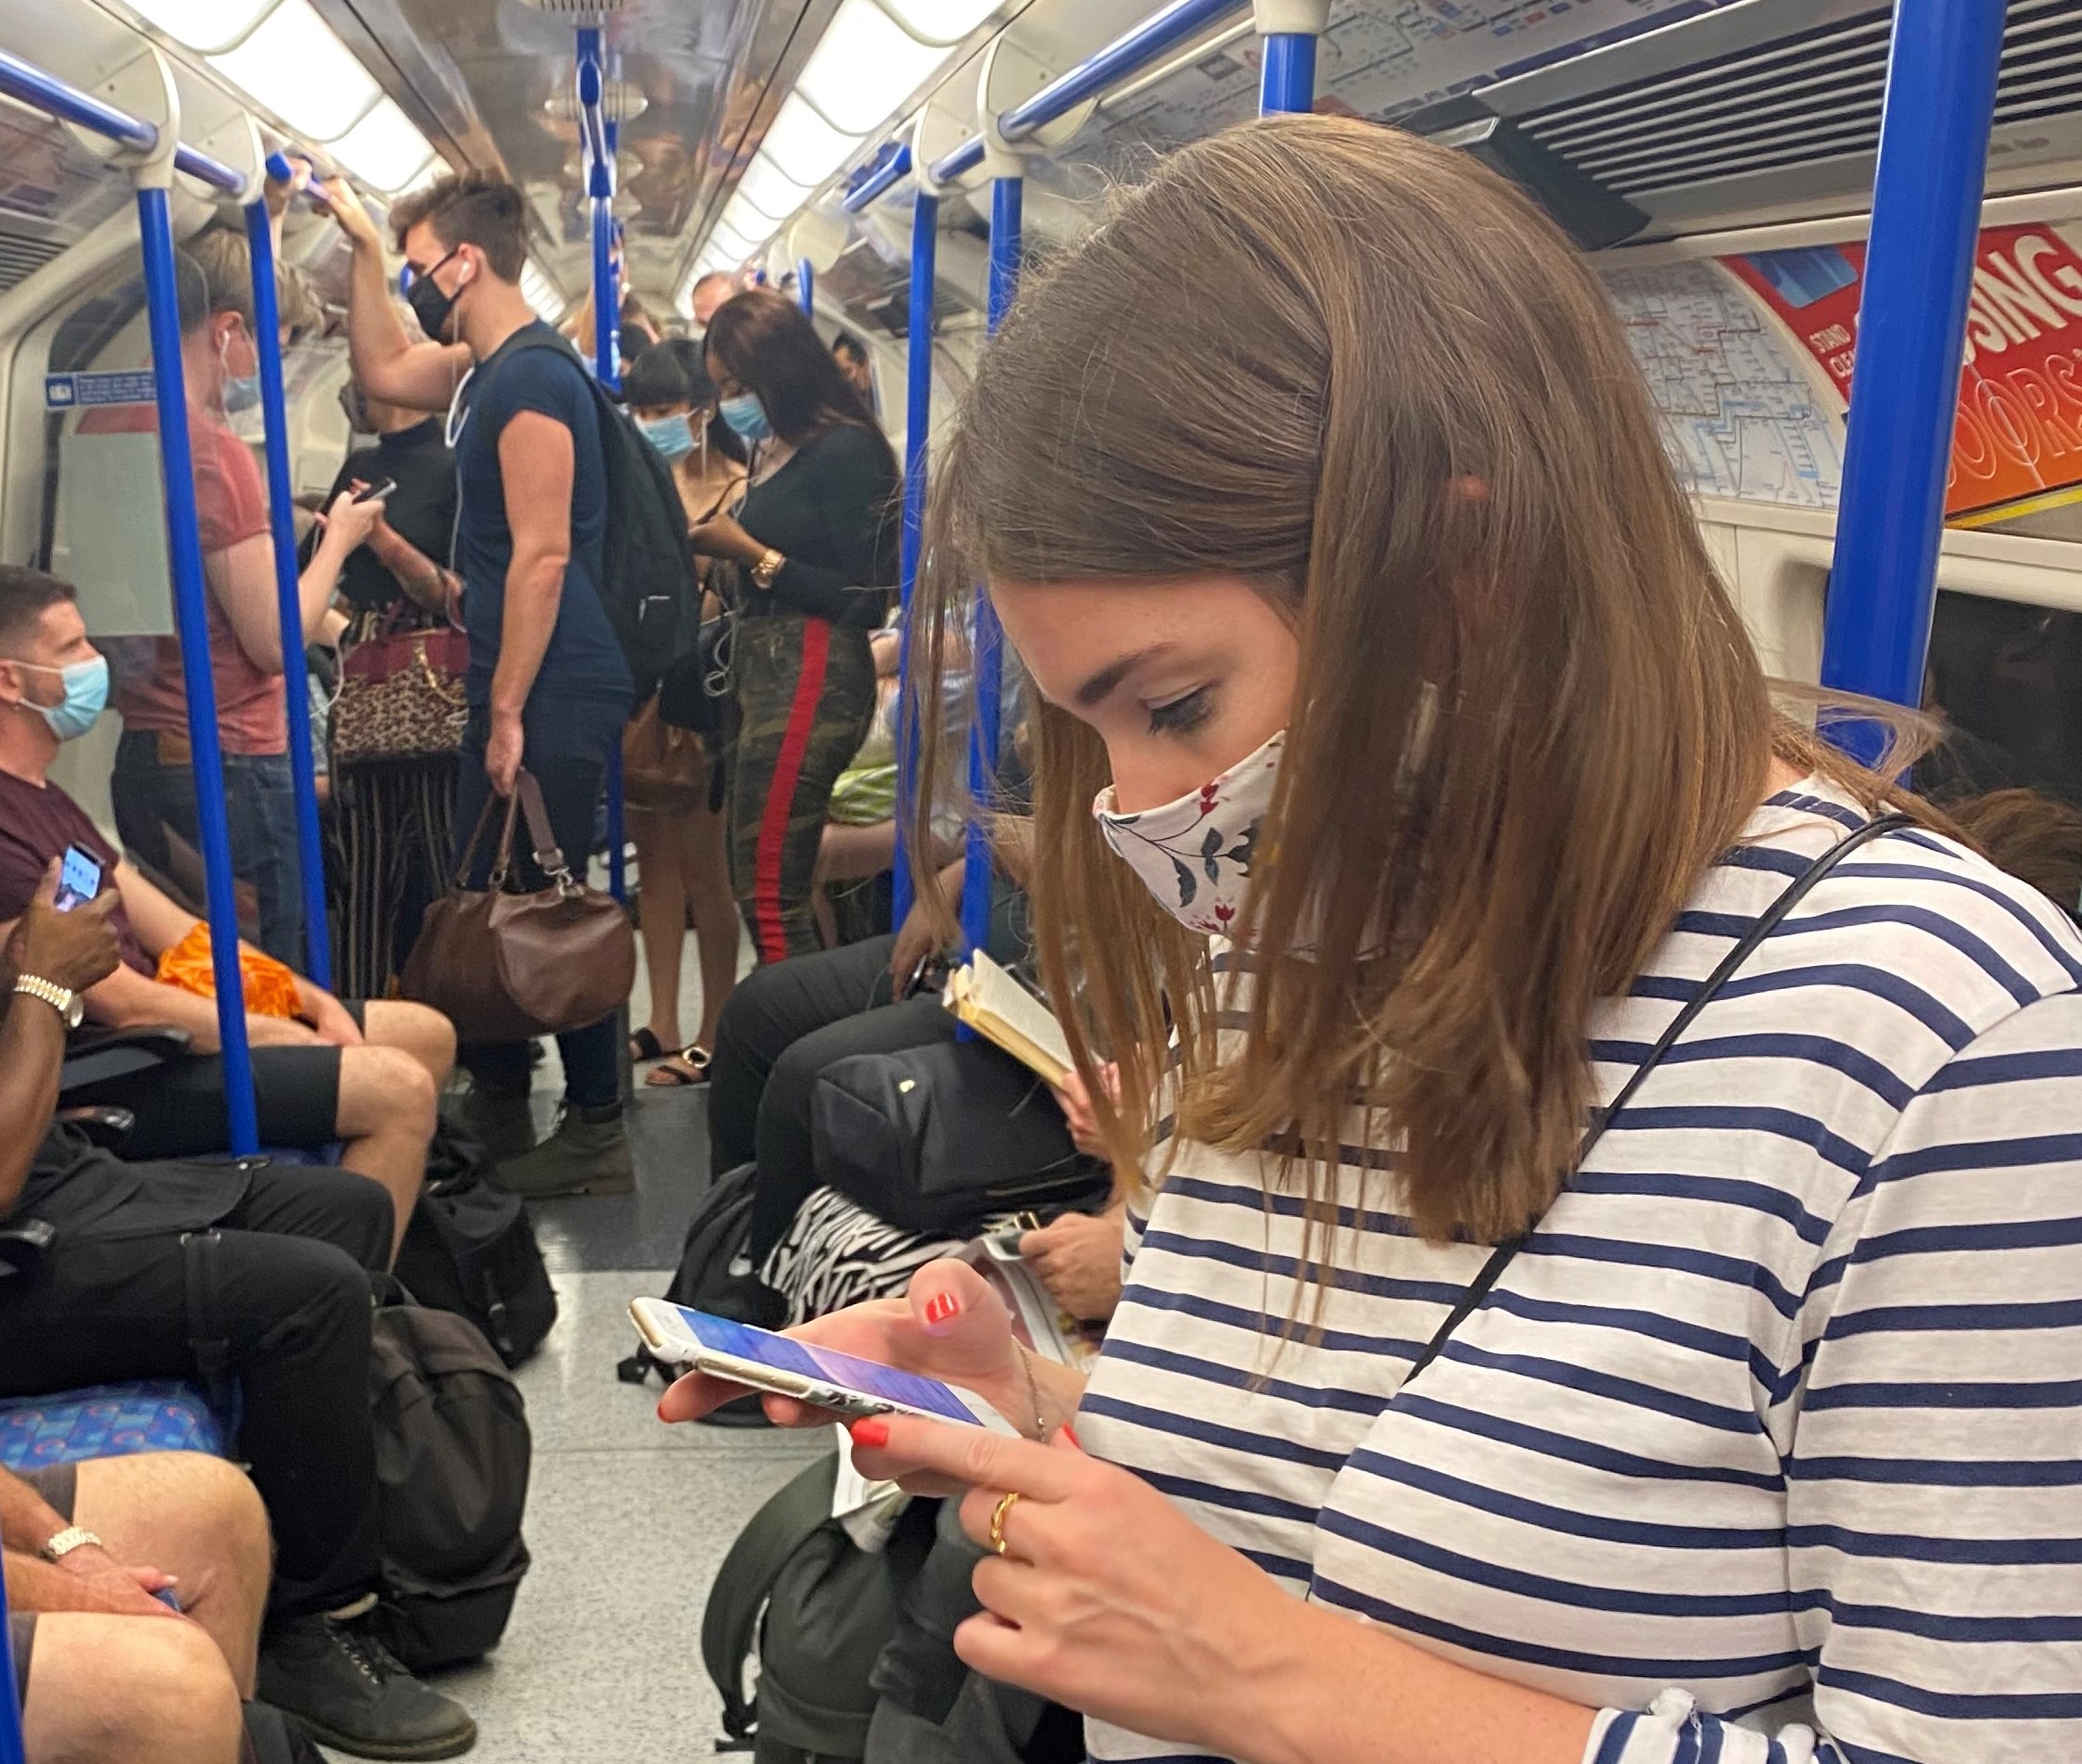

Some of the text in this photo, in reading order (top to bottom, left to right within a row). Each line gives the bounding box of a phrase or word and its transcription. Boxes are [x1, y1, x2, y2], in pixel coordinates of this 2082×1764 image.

[1809, 324, 1851, 353] STAND
[1962, 235, 2082, 364] SING
[1949, 354, 2082, 488] OORS
